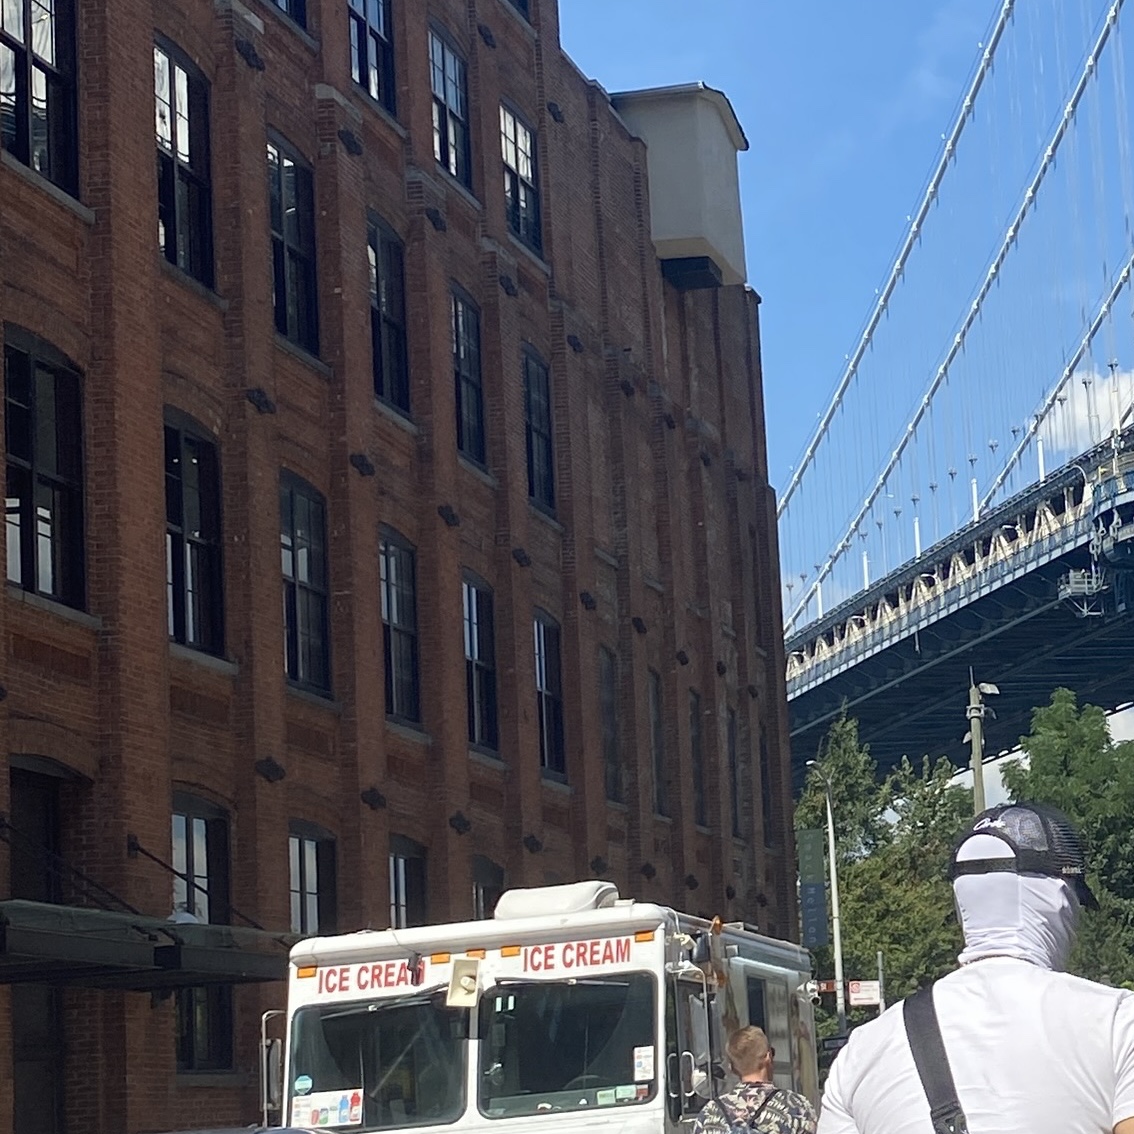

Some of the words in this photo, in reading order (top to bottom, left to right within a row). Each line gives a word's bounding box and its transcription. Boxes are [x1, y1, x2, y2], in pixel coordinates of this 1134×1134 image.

[523, 945, 555, 972] ICE
[562, 938, 631, 968] CREAM
[318, 966, 350, 994] ICE
